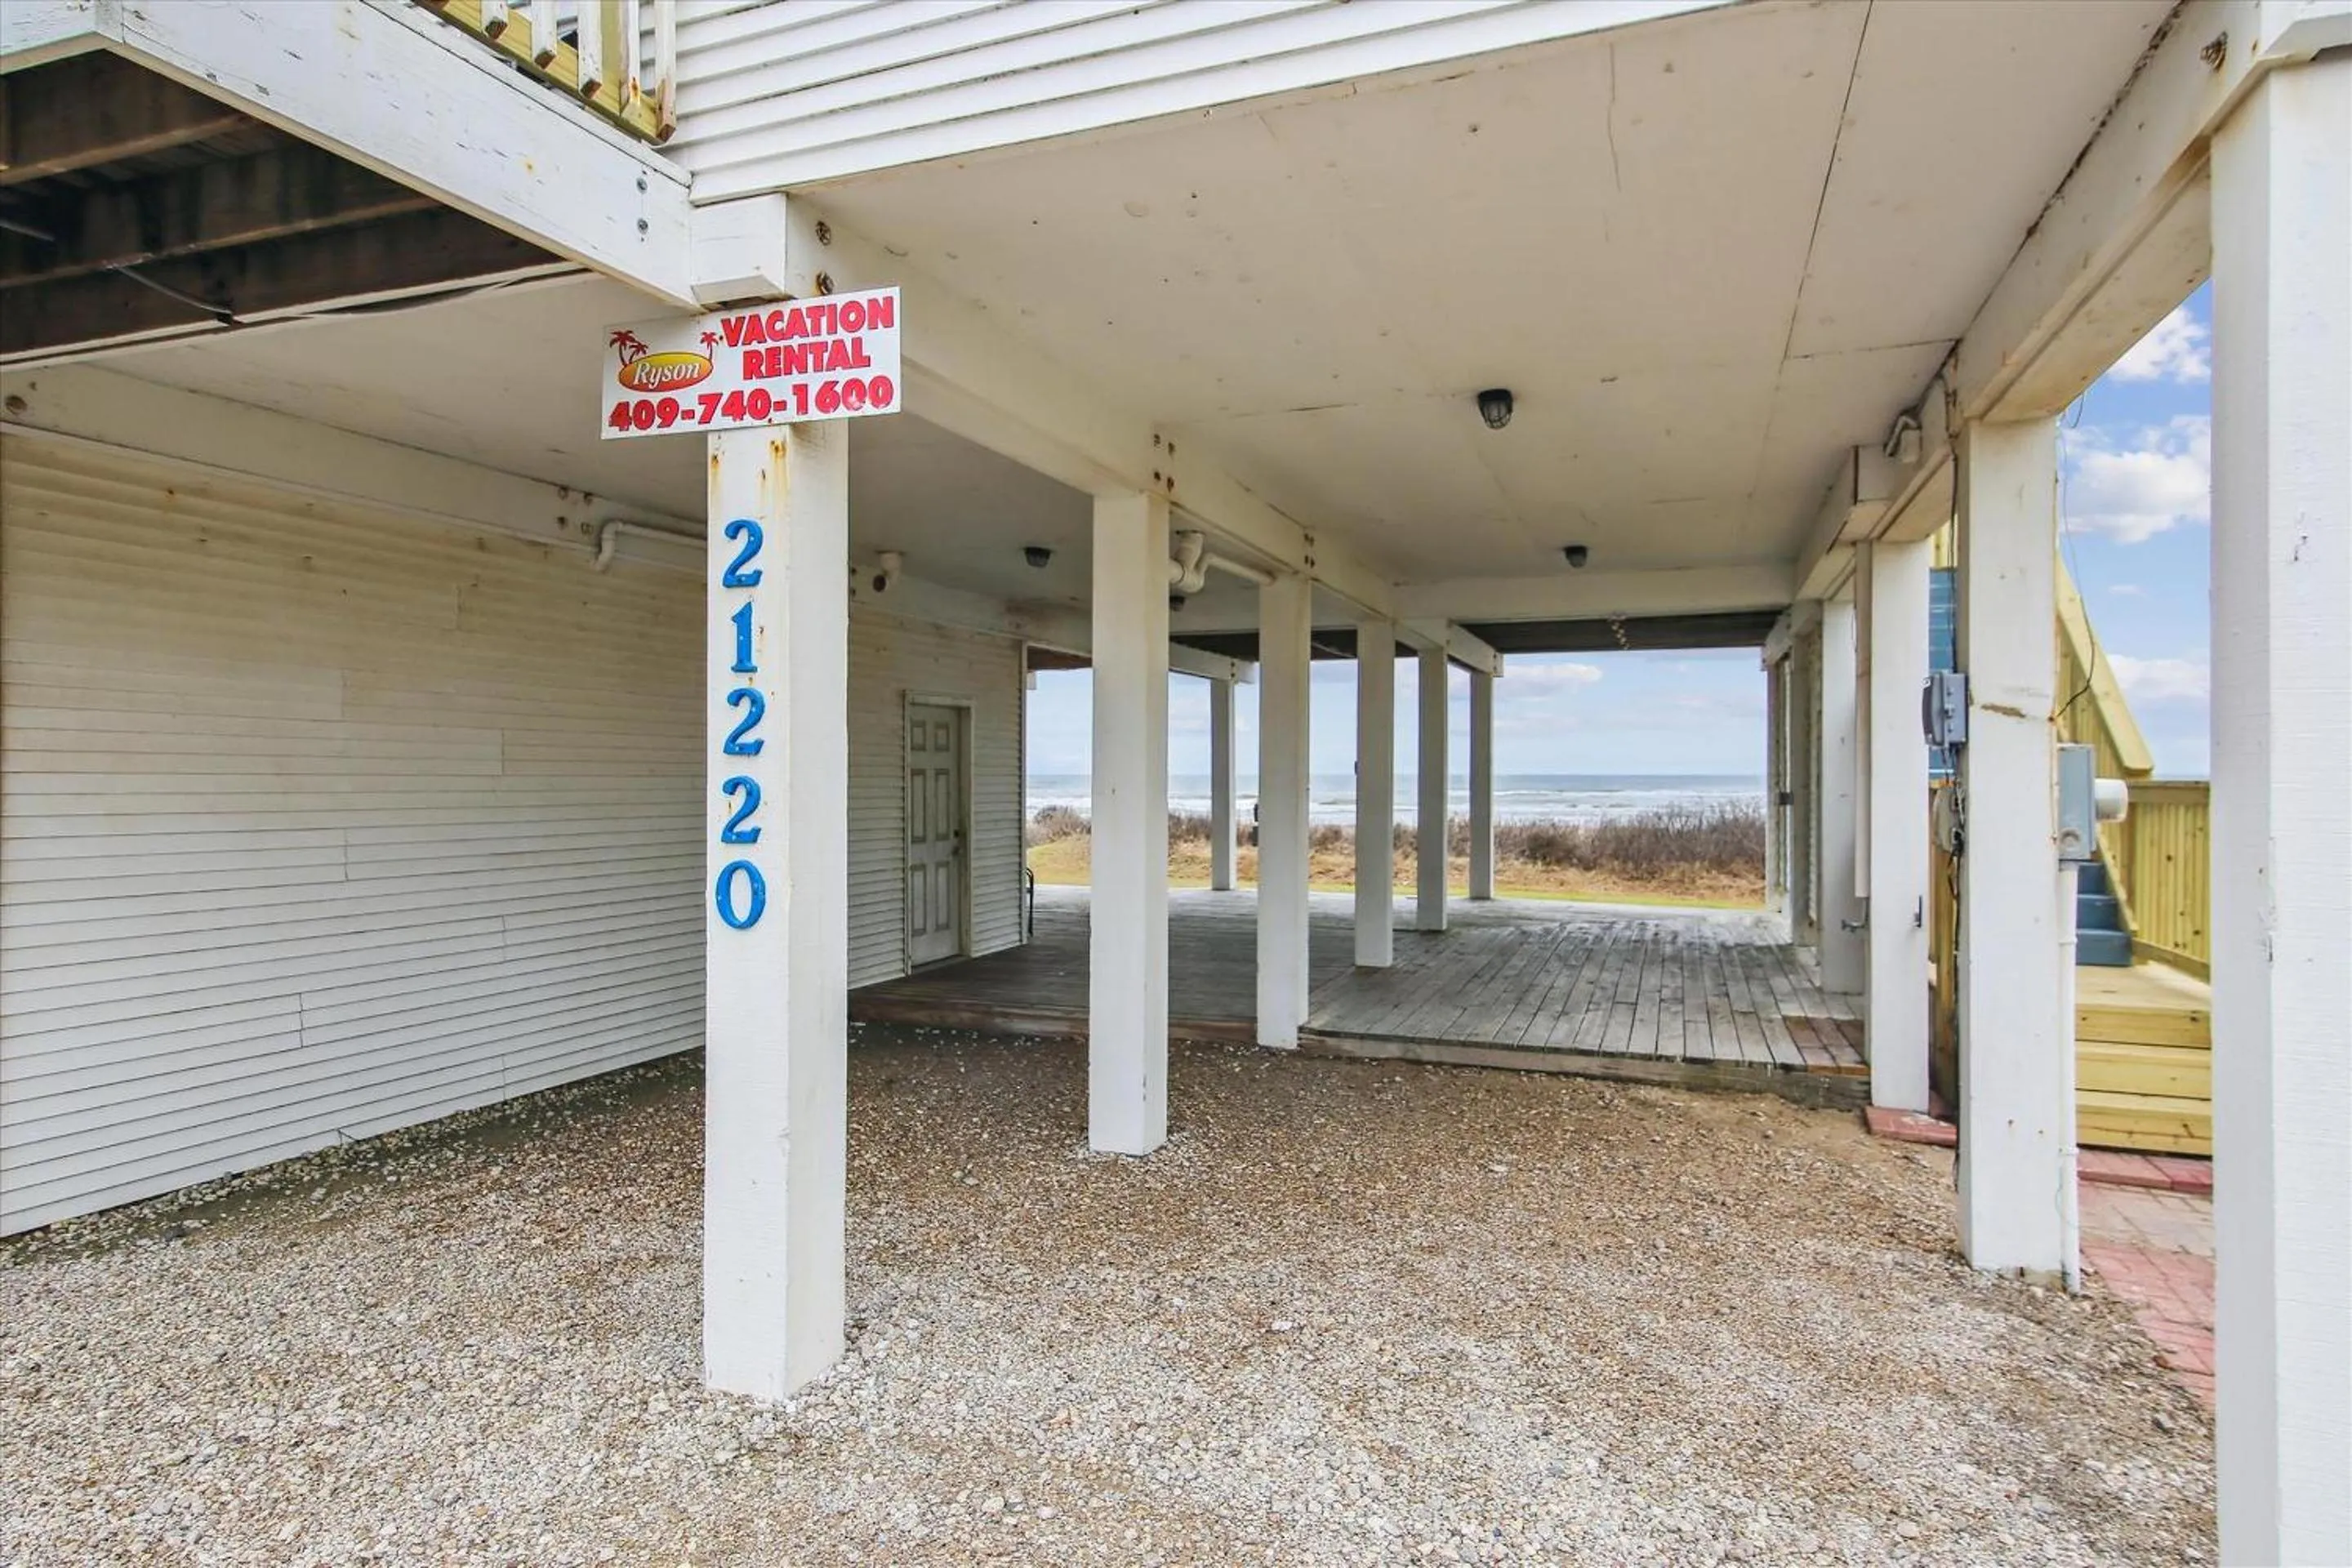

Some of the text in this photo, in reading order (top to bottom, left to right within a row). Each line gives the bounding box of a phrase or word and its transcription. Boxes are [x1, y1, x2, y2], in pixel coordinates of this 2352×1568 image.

[720, 296, 894, 347] VACATION
[633, 360, 701, 388] Ryson
[742, 337, 871, 381] RENTAL
[608, 375, 894, 432] 409-740-1600
[715, 519, 766, 930] 21220
